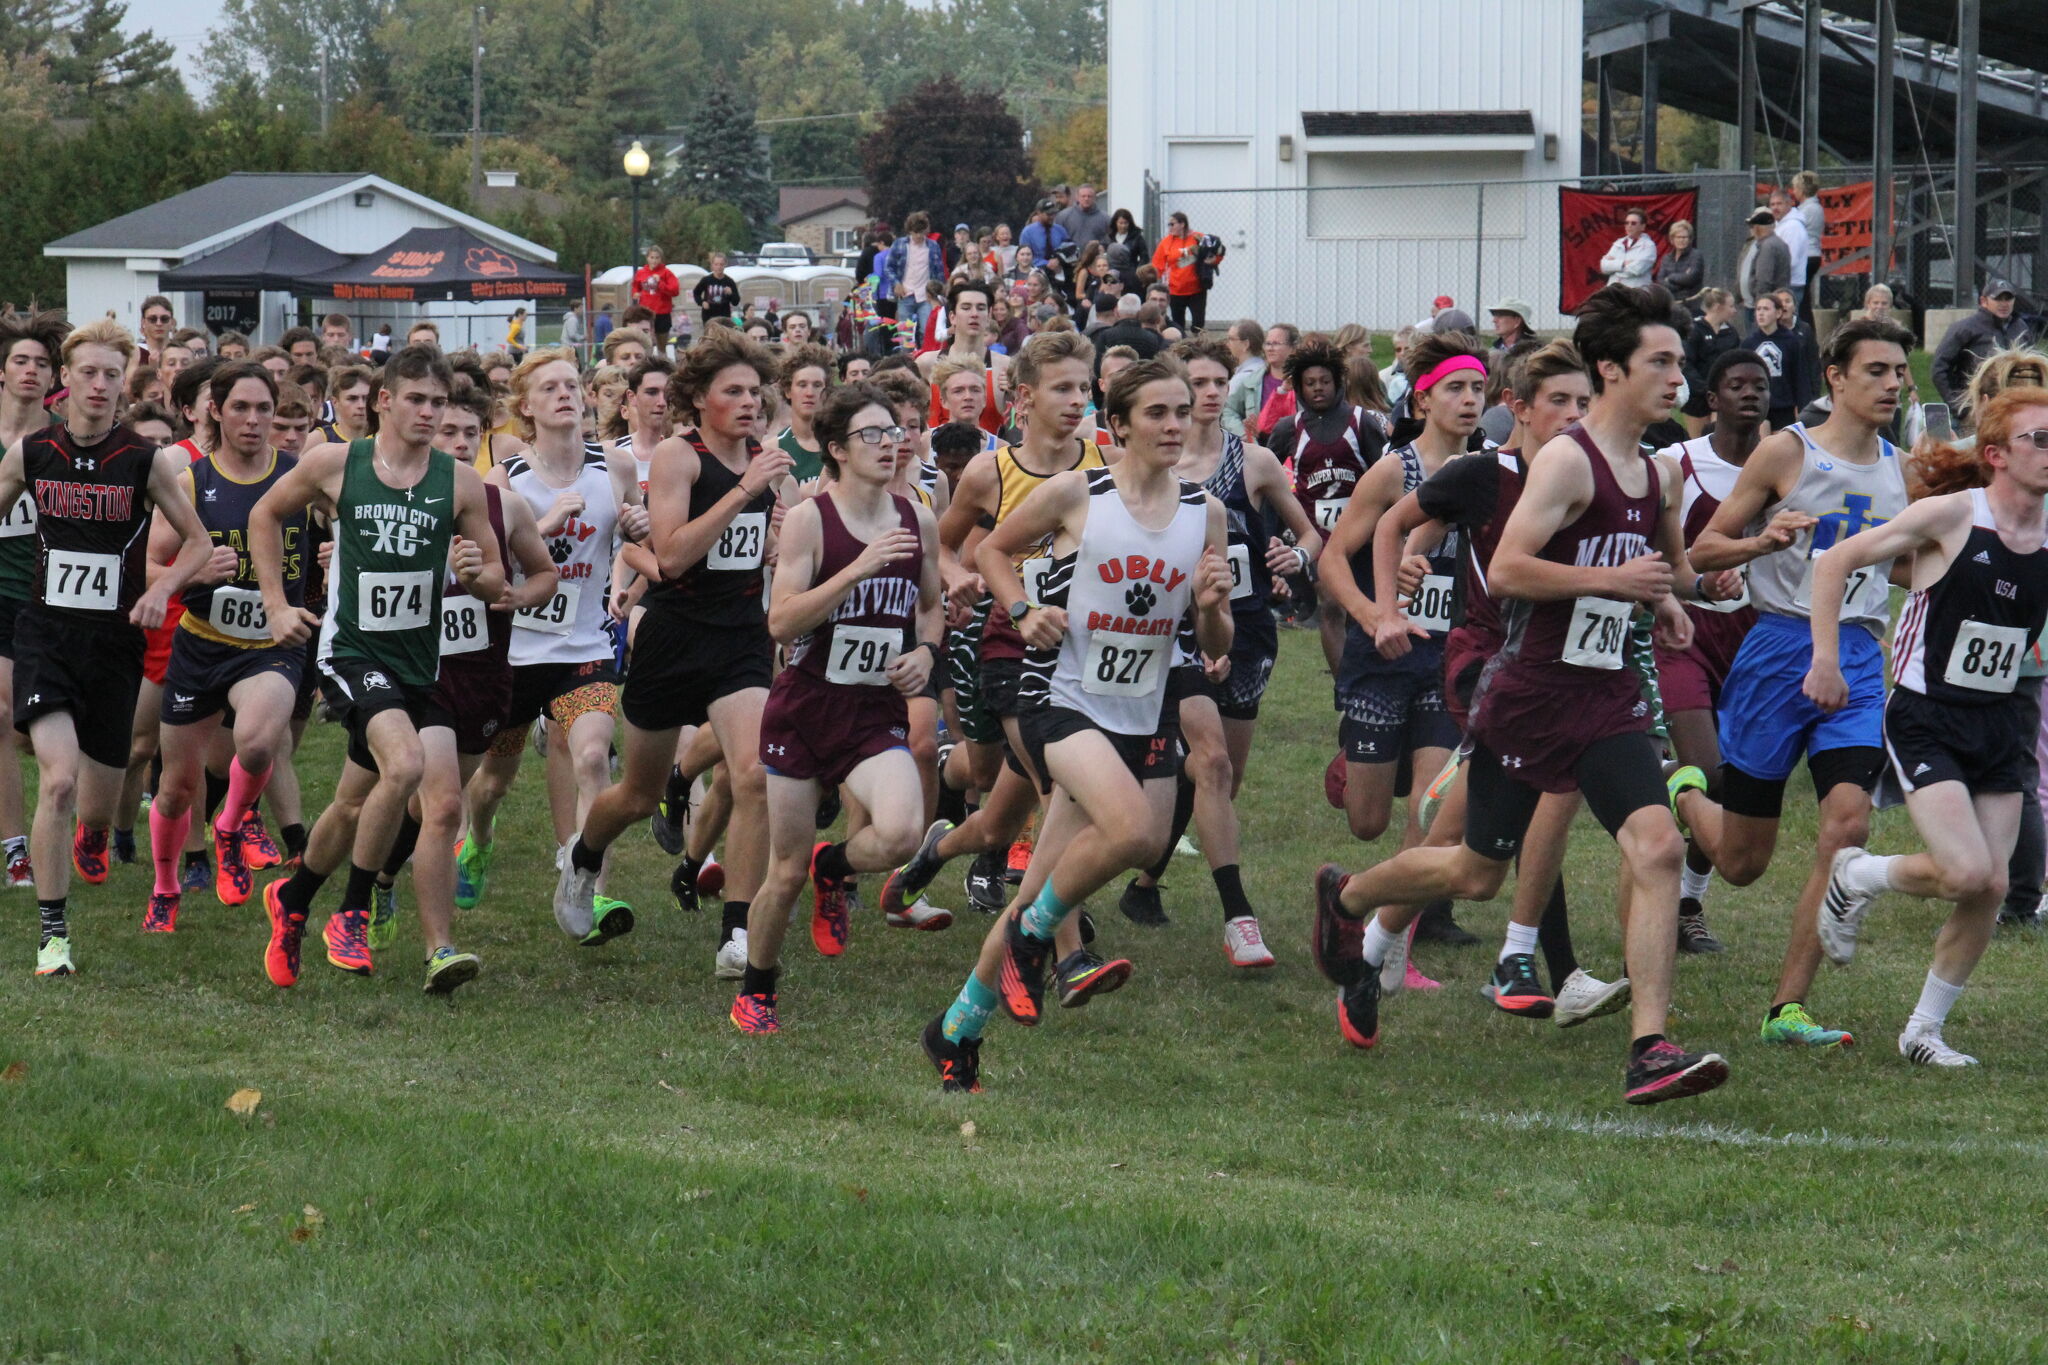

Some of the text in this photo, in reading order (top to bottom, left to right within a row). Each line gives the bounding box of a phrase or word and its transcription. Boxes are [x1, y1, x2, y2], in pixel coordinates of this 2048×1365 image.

[207, 305, 237, 321] 2017
[35, 479, 135, 522] KINGSTON
[354, 503, 439, 531] BROWN CITY
[371, 519, 418, 558] XC
[718, 525, 760, 559] 823
[57, 563, 108, 598] 774
[1097, 555, 1187, 593] UBLY
[1994, 578, 2018, 600] USA
[221, 597, 267, 630] 683
[371, 584, 423, 619] 674
[1407, 587, 1452, 620] 806
[442, 607, 478, 643] 88
[1087, 610, 1174, 637] BEARCATS
[838, 638, 891, 674] 791
[1096, 645, 1154, 684] 827
[1962, 637, 2017, 679] 834
